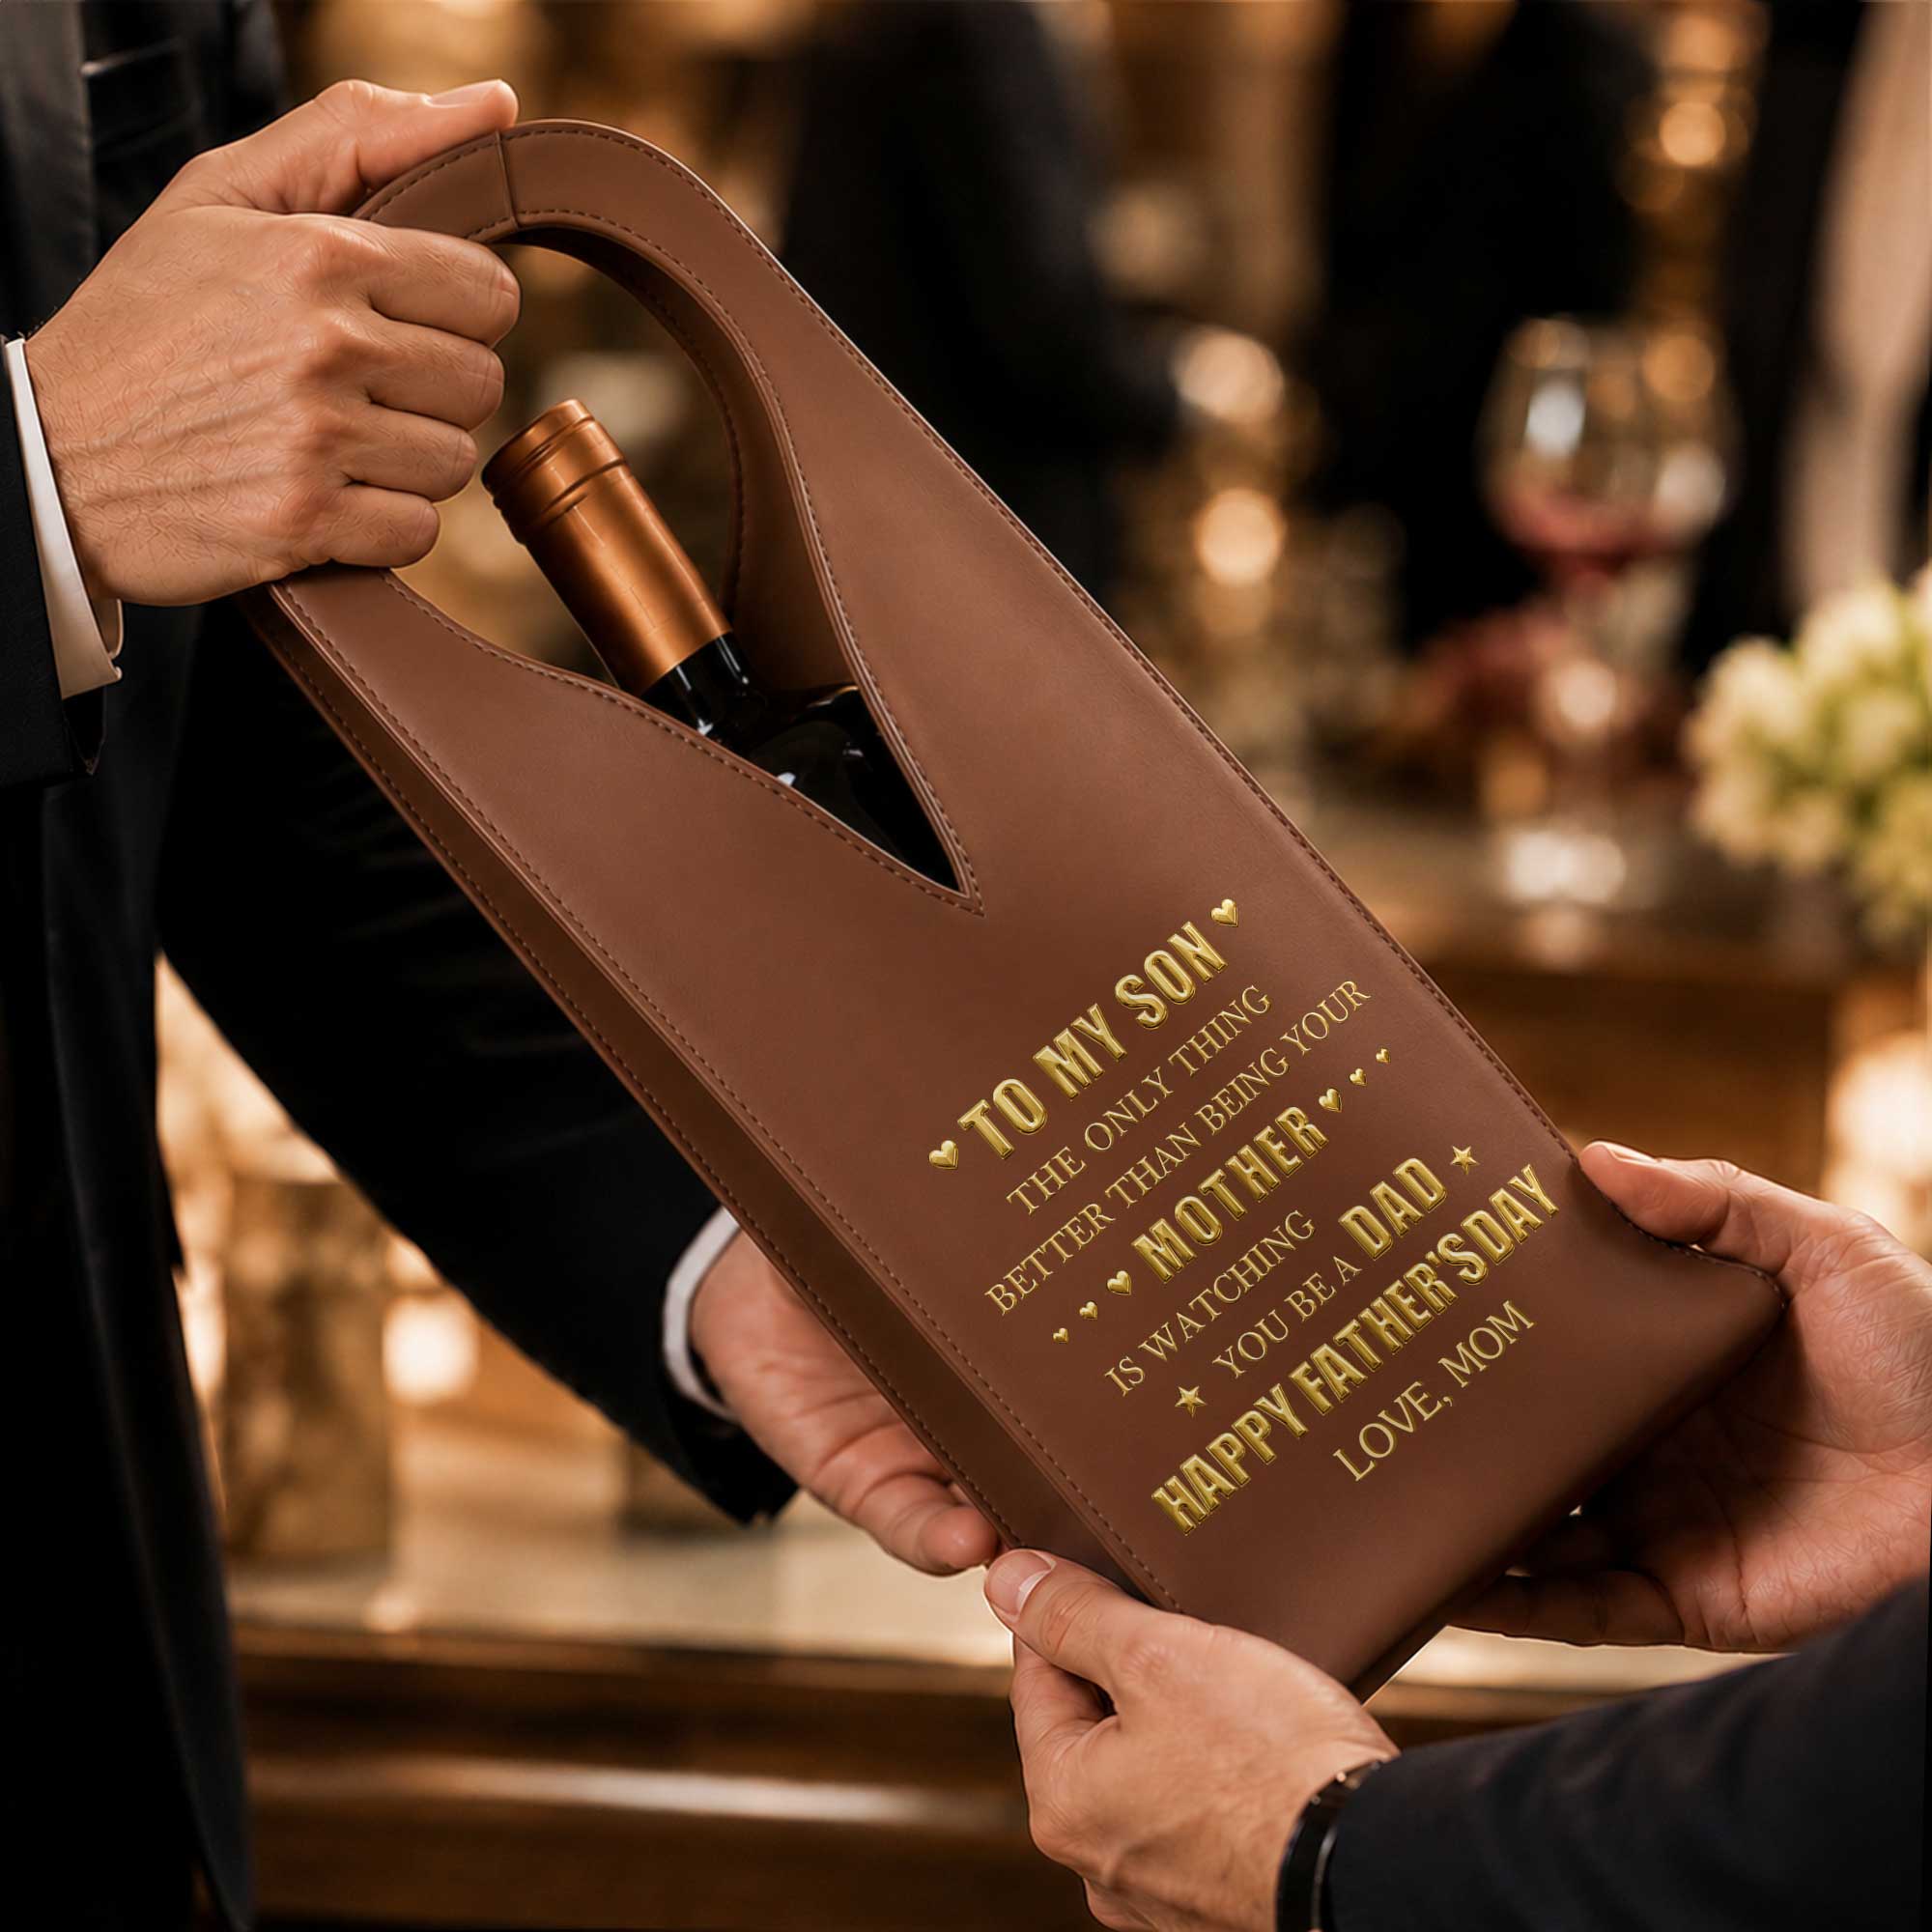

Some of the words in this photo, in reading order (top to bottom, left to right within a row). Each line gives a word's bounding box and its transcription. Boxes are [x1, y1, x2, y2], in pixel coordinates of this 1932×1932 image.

[957, 1077, 1048, 1160] TO
[1033, 1003, 1127, 1100] MY
[1114, 921, 1229, 1030] SON
[1006, 1148, 1087, 1216] THE
[1084, 1067, 1174, 1153] ONLY
[1168, 984, 1272, 1078] THING
[984, 1203, 1116, 1316] BETTER
[1106, 1135, 1203, 1209] THAN
[1194, 1047, 1290, 1136] BEING
[1280, 980, 1372, 1059] YOUR
[1130, 1105, 1329, 1283] MOTHER
[1338, 1157, 1446, 1260] DAD
[1104, 1356, 1145, 1397] IS
[1138, 1210, 1317, 1364] WATCHING
[1213, 1310, 1289, 1380] YOU
[1285, 1272, 1337, 1321] BE
[1335, 1254, 1362, 1285] A
[1151, 1383, 1308, 1535] HAPPY
[1332, 1380, 1453, 1482] LOVE,
[1438, 1299, 1535, 1389] MOM
